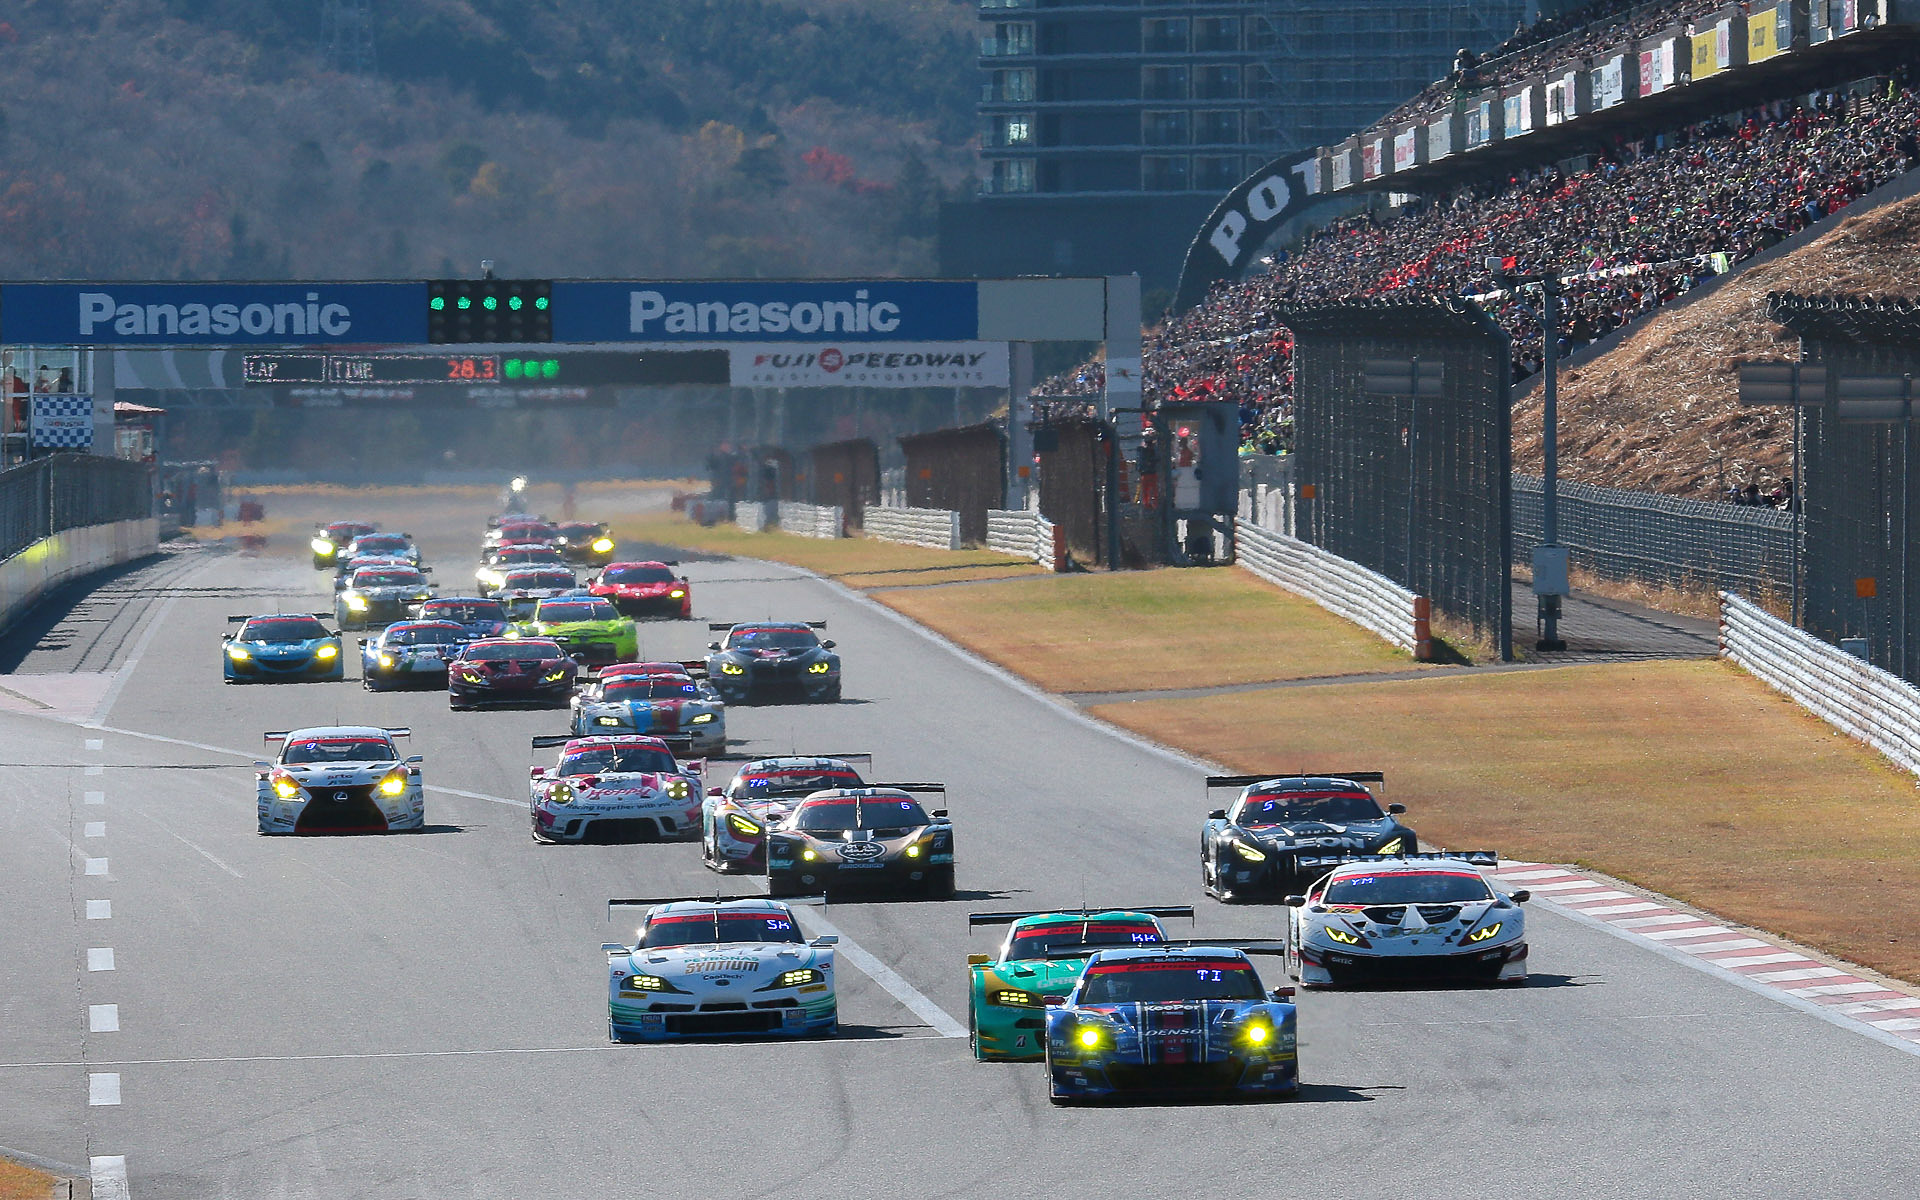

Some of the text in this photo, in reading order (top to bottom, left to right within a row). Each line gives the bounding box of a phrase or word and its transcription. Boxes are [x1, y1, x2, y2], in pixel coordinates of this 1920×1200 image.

[78, 291, 352, 337] Panasonic
[628, 289, 901, 334] Panasonic
[753, 350, 986, 371] FUJI SPEEDWAY
[248, 359, 495, 379] LAP TIME 28.3
[1275, 836, 1365, 851] LEON
[684, 955, 760, 963] PETRONAS
[684, 960, 760, 975] SYNTIUM
[703, 973, 743, 981] CoolTech
[1144, 1027, 1203, 1037] DENSO
